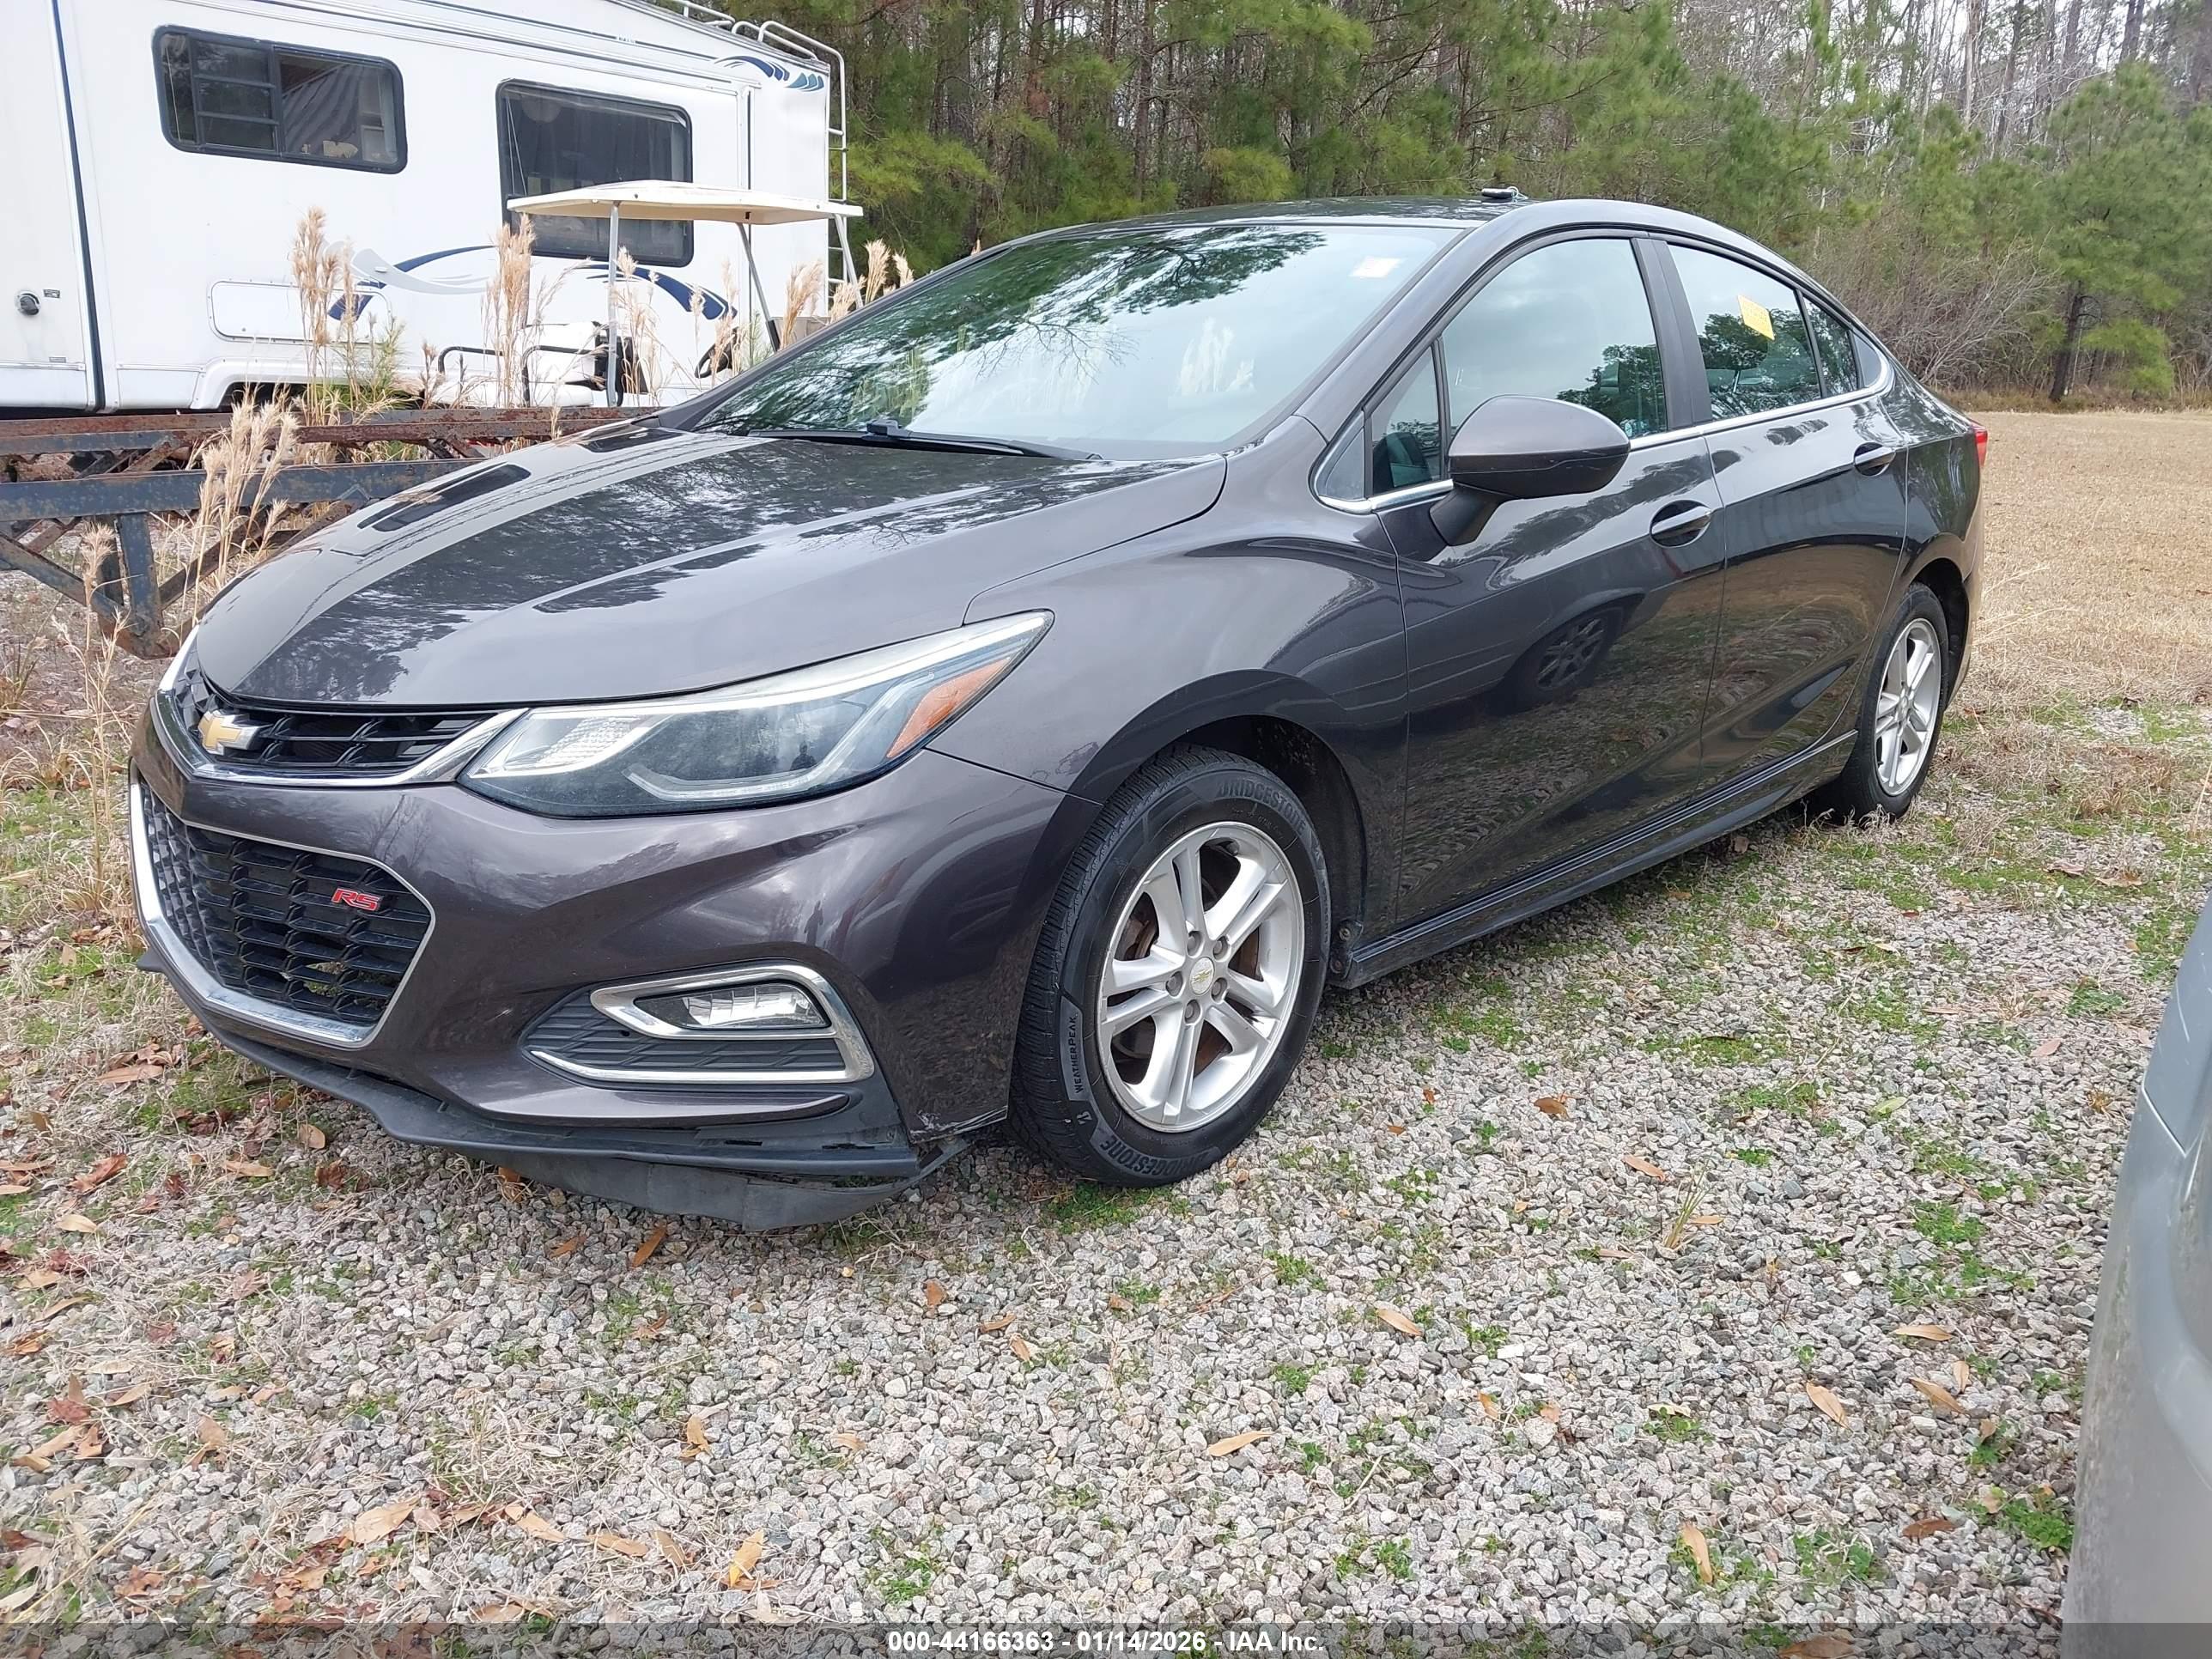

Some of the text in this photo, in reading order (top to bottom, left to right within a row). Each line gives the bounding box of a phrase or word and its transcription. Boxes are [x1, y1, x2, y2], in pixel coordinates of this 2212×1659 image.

[1216, 778, 1308, 837] BRIDGESTONE
[331, 888, 380, 911] RS
[1067, 1015, 1085, 1094] WEATHERPEAK
[1099, 1134, 1211, 1176] BRIDGESTONE
